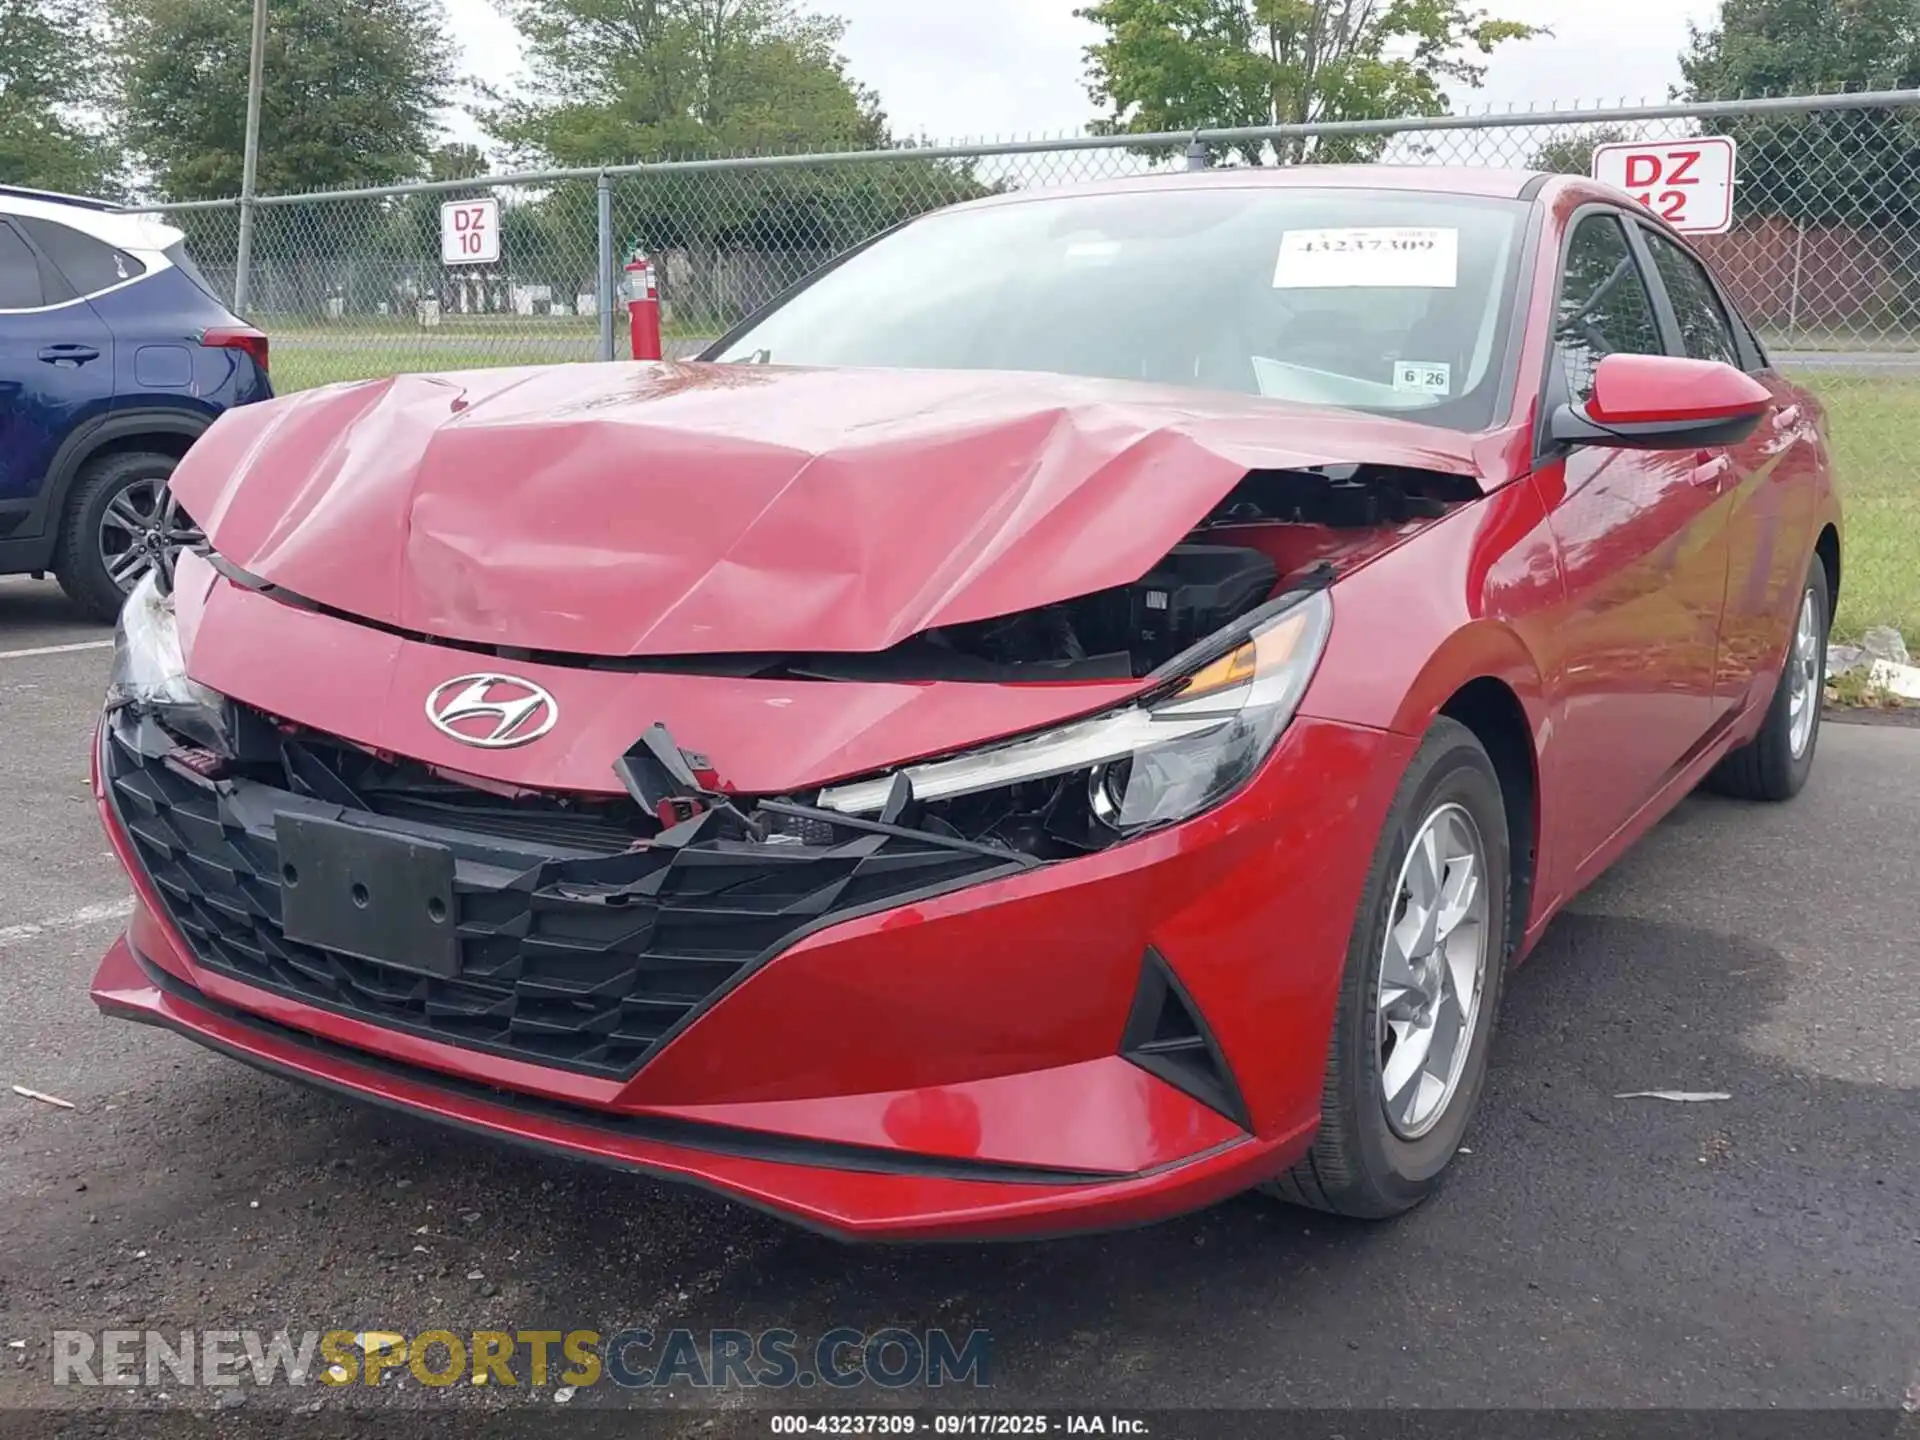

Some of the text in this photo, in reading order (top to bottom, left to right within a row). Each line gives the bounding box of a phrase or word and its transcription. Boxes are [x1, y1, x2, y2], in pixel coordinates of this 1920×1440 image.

[1625, 151, 1701, 188] DZ
[455, 208, 485, 231] DZ
[459, 232, 482, 254] 10
[1404, 370, 1444, 386] 6 26
